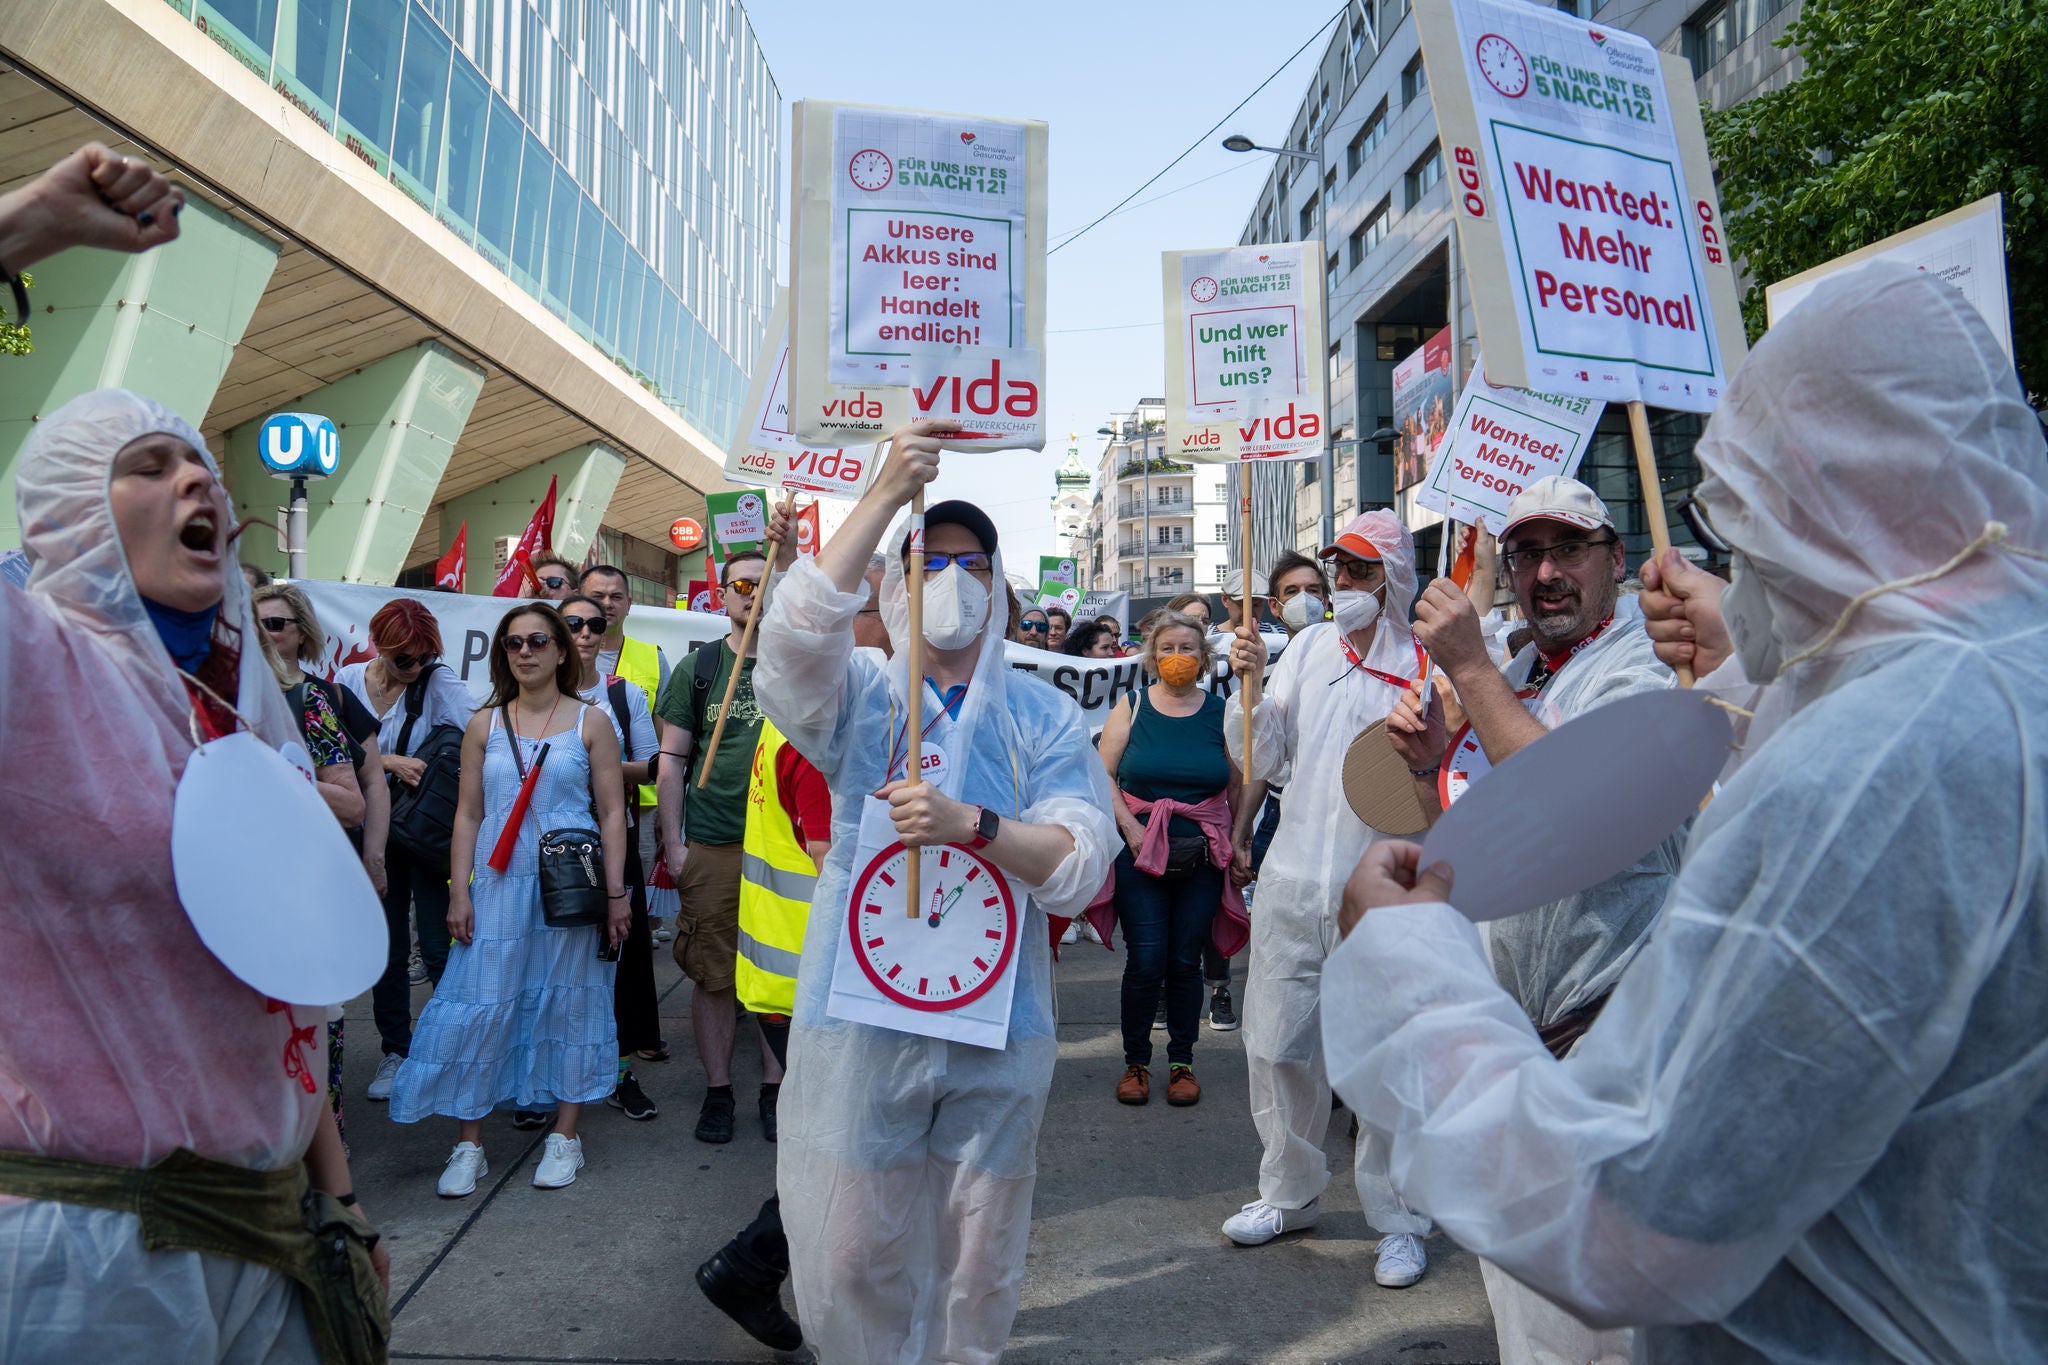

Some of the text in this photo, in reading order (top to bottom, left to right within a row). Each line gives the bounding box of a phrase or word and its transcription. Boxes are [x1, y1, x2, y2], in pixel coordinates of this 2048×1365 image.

[1606, 46, 1644, 64] Offensive
[1608, 56, 1655, 76] Gesundheit
[1530, 54, 1652, 101] FÜR UNS IST ES
[1535, 74, 1656, 124] 5 NACH 12!
[345, 133, 378, 171] Nikon
[973, 143, 1007, 154] Offensive
[973, 150, 1016, 161] Gesundheit
[898, 157, 1008, 179] FÜR UNS IST ES
[898, 171, 1006, 194] 5 NACH 12!
[1513, 161, 1673, 229] Wanted:
[888, 220, 974, 243] Unsere
[477, 243, 505, 274] SIEMENS
[862, 244, 997, 271] Akkus sind
[1558, 221, 1652, 273] Mehr
[903, 270, 960, 292] leer:
[1220, 277, 1238, 287] FÜR
[1240, 276, 1260, 284] UNS
[1262, 274, 1277, 282] IST
[1221, 281, 1290, 296] 5 NACH 12!
[881, 296, 980, 319] Handelt
[1534, 268, 1696, 331] Personal
[878, 322, 980, 345] endlich!
[1199, 323, 1288, 344] Und wer
[1223, 344, 1267, 363] hilft
[912, 358, 1038, 417] vida
[1219, 366, 1272, 387] uns?
[822, 391, 883, 418] vida
[1566, 398, 1588, 416] 12!
[820, 421, 883, 430] www.vida.at
[962, 420, 1038, 432] GEWERKSCHAFT
[1239, 402, 1320, 443] vida
[268, 425, 303, 465] U
[319, 427, 337, 470] U
[1182, 428, 1221, 446] vida
[1272, 440, 1320, 450] GEWERKSCHAFT
[1471, 413, 1564, 463] Wanted:
[738, 466, 773, 476] www.vida.at
[741, 452, 775, 469] vida
[788, 448, 863, 482] vida
[1476, 443, 1536, 477] Mehr
[793, 474, 811, 483] LEBEN
[1447, 458, 1523, 497] Person
